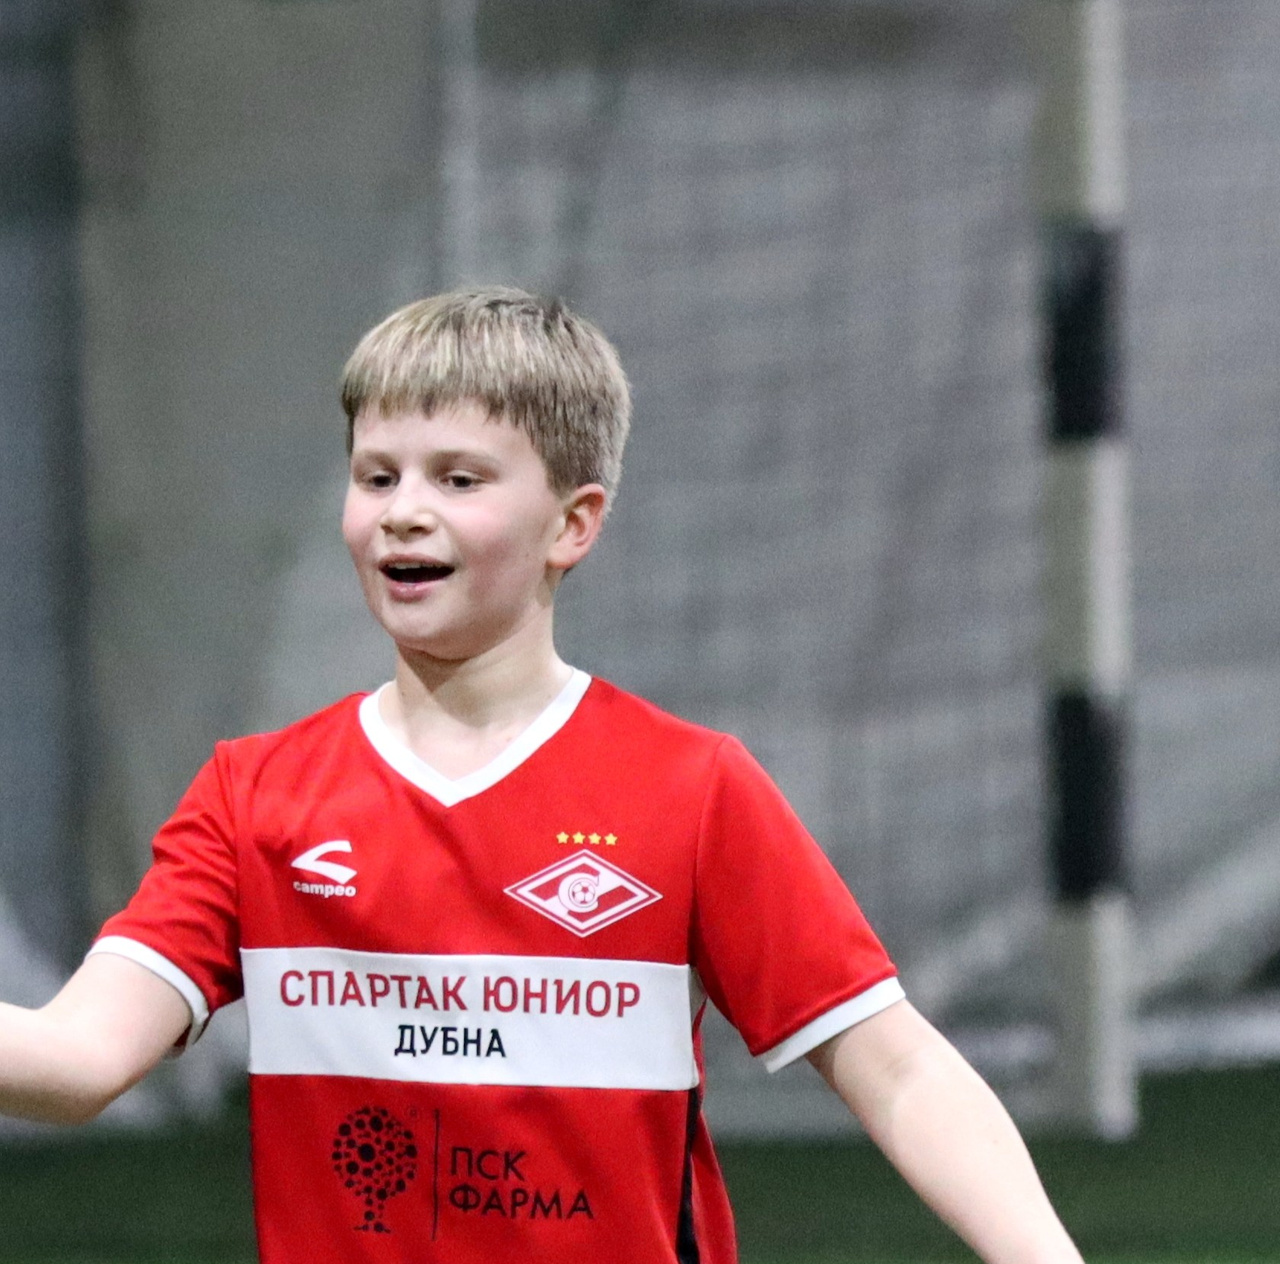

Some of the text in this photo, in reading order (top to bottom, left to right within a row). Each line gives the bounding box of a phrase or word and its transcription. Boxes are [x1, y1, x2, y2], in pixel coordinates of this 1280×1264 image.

[293, 881, 357, 898] campeo
[280, 970, 640, 1018] СПАРТАК ЮНИОР
[394, 1024, 507, 1058] ДУБНА
[450, 1146, 527, 1182] ПСК
[449, 1184, 595, 1220] ФАРМА
